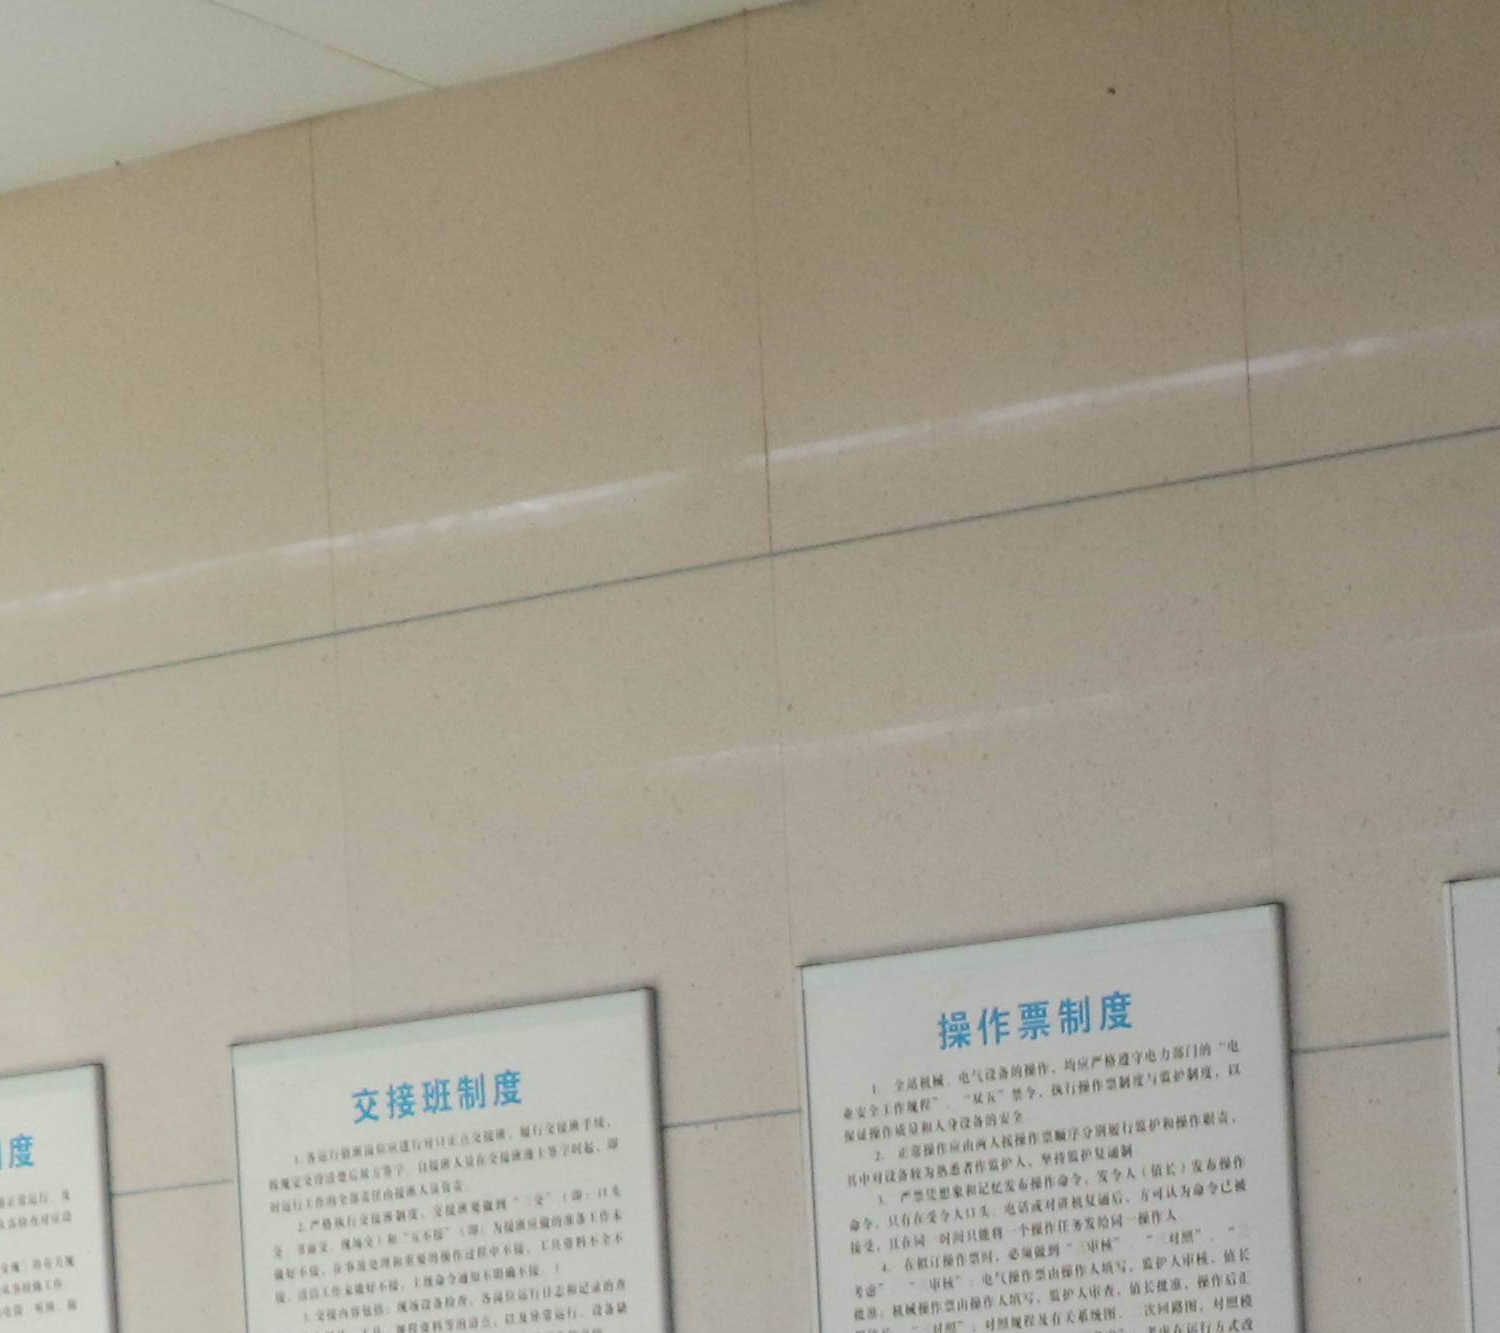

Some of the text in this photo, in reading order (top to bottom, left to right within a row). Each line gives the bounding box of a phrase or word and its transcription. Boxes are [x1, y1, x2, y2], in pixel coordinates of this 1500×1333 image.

[938, 989, 1133, 1052] 操作票制度
[352, 1068, 522, 1124] 交接班制度
